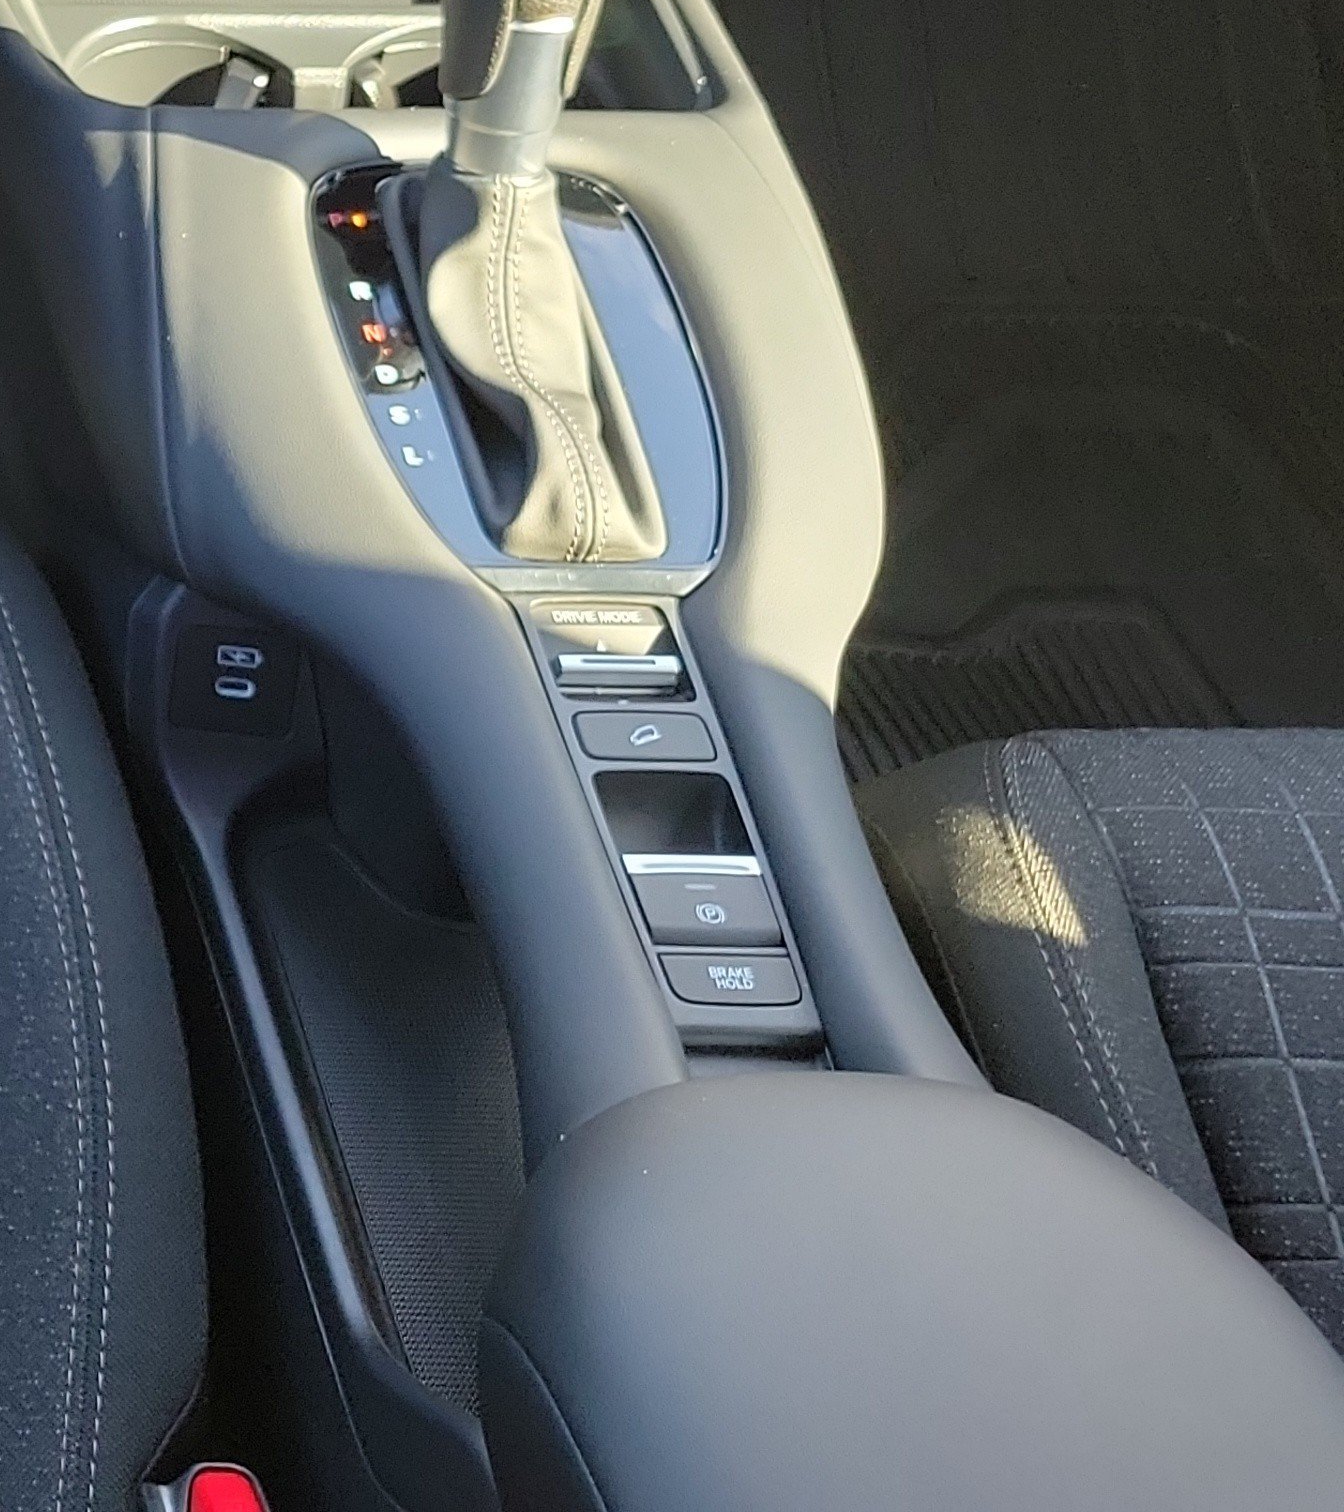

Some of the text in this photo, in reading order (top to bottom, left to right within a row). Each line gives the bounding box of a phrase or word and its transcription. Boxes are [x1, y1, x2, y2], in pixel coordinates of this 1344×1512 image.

[362, 324, 387, 343] N
[375, 364, 399, 385] D
[389, 405, 411, 426] S
[402, 445, 424, 467] L
[552, 610, 643, 624] DRIVE MODE
[708, 966, 754, 979] BRAKE
[715, 978, 754, 990] HOLD
